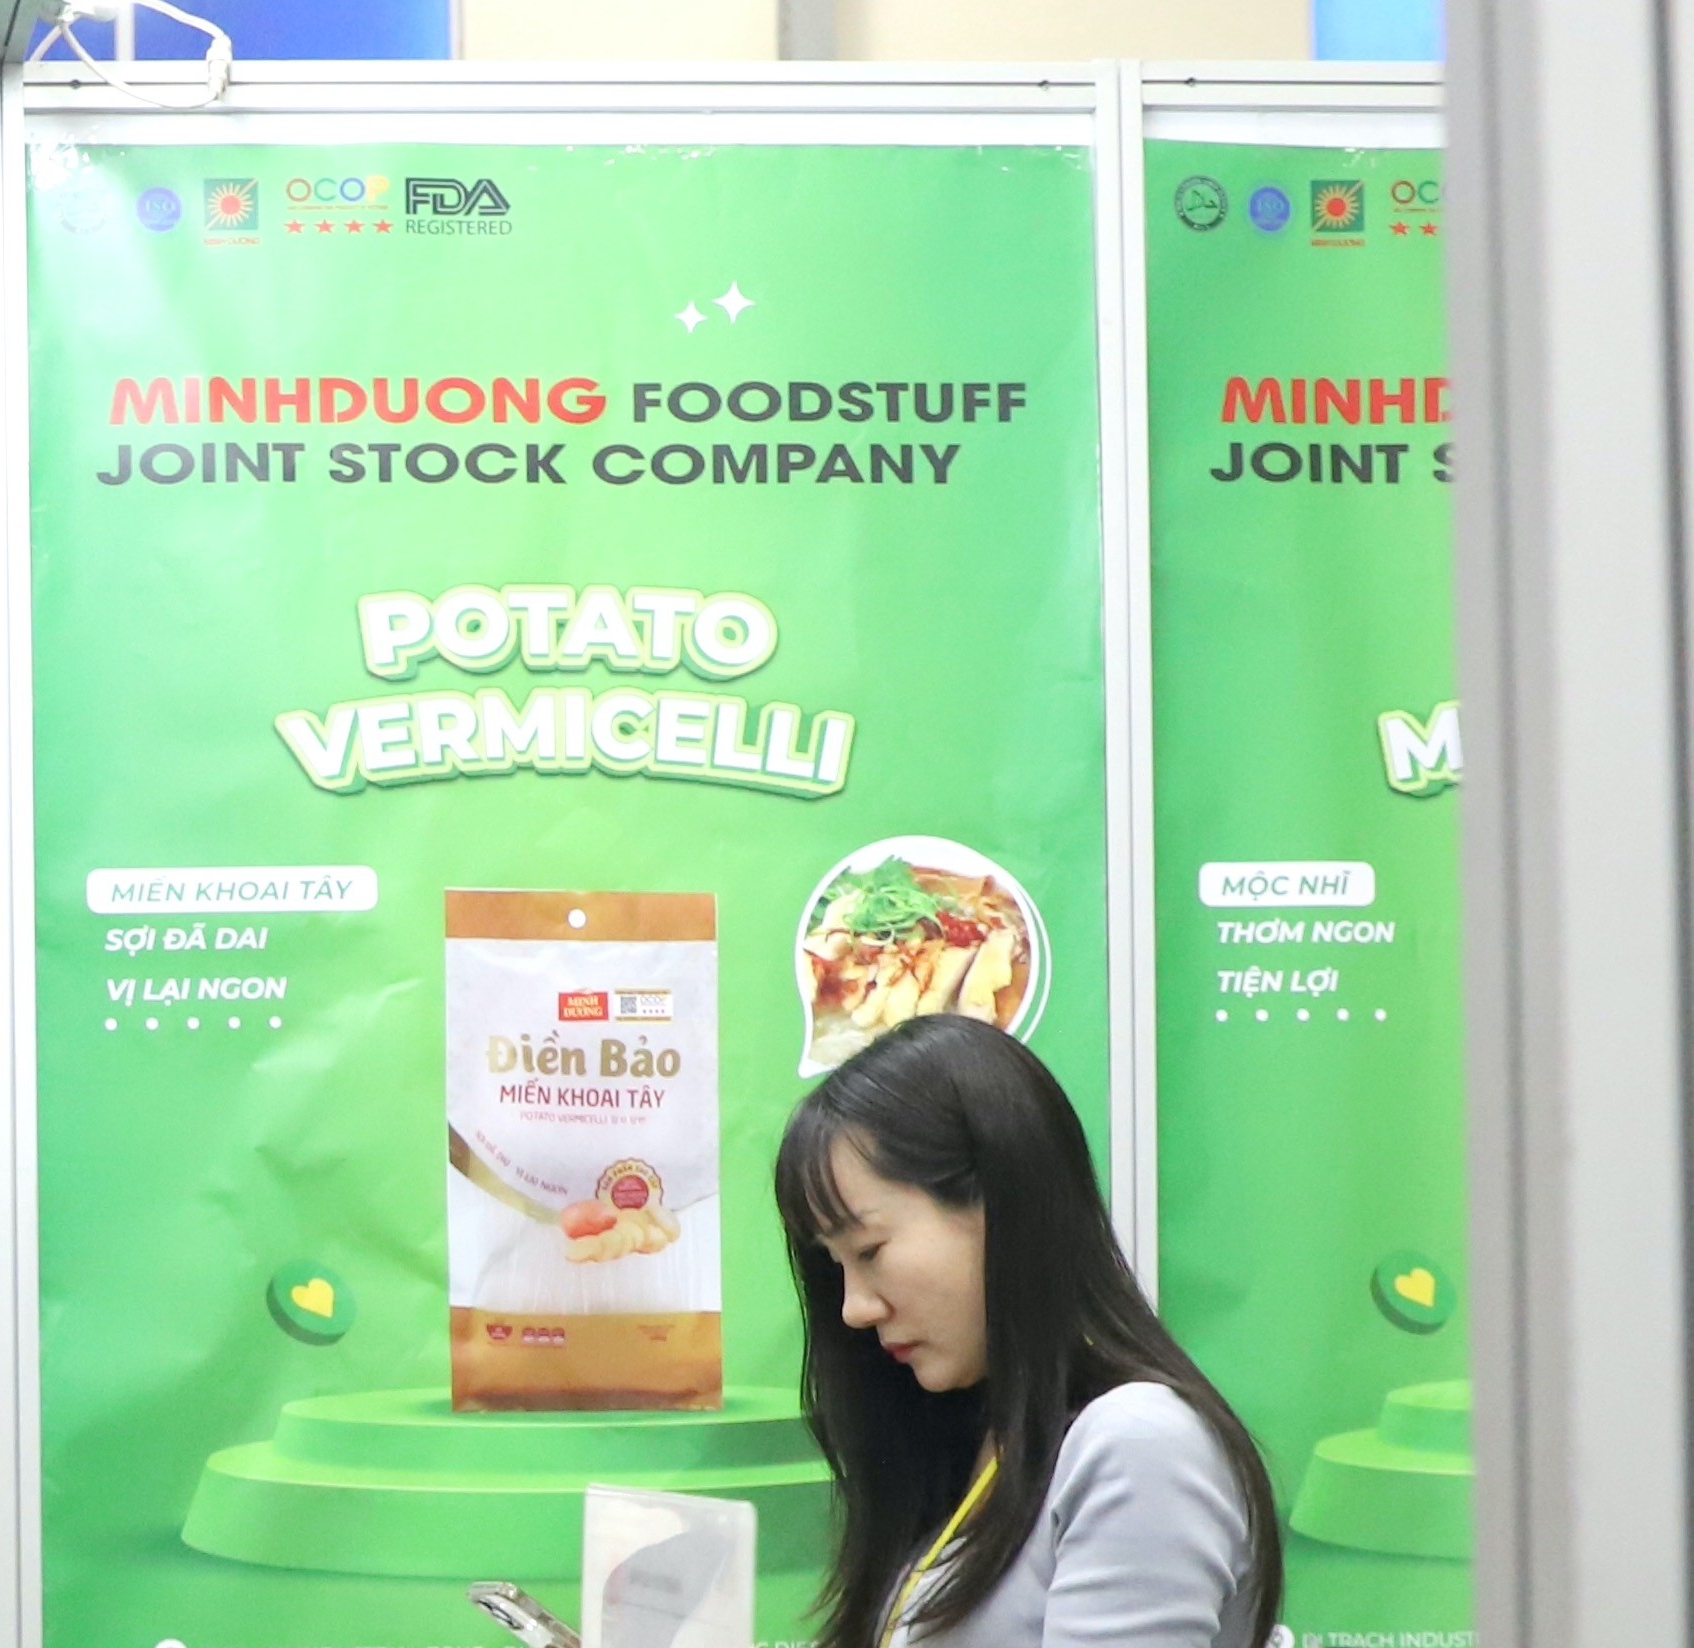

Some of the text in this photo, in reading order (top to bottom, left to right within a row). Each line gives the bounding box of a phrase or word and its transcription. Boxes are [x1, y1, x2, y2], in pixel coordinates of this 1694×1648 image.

[287, 176, 390, 202] OCOP
[406, 178, 510, 215] FDA
[406, 219, 512, 235] REGISTERED
[109, 377, 1027, 424] MINHDUONG FOODSTUFF
[96, 442, 961, 486] JOINT STOCK COMPANY
[1210, 442, 1409, 483] JOINT
[366, 588, 773, 672] POTATO
[281, 690, 853, 790] VERMICELLI
[195, 881, 288, 901] KHOAI
[300, 875, 352, 900] TÂY
[1222, 869, 1350, 901] MỘC NHĨ
[105, 923, 268, 956] SỢI ĐÃ DAI
[1217, 917, 1395, 944] THƠM NGON
[107, 976, 287, 1006] VỊ LẠI NGON
[1217, 966, 1338, 998] TIỆN LỢI
[487, 1030, 681, 1078] Điền Bảo
[558, 1088, 619, 1108] KHOAI
[627, 1086, 665, 1109] TÂY
[1329, 1632, 1394, 1648] TRACH
